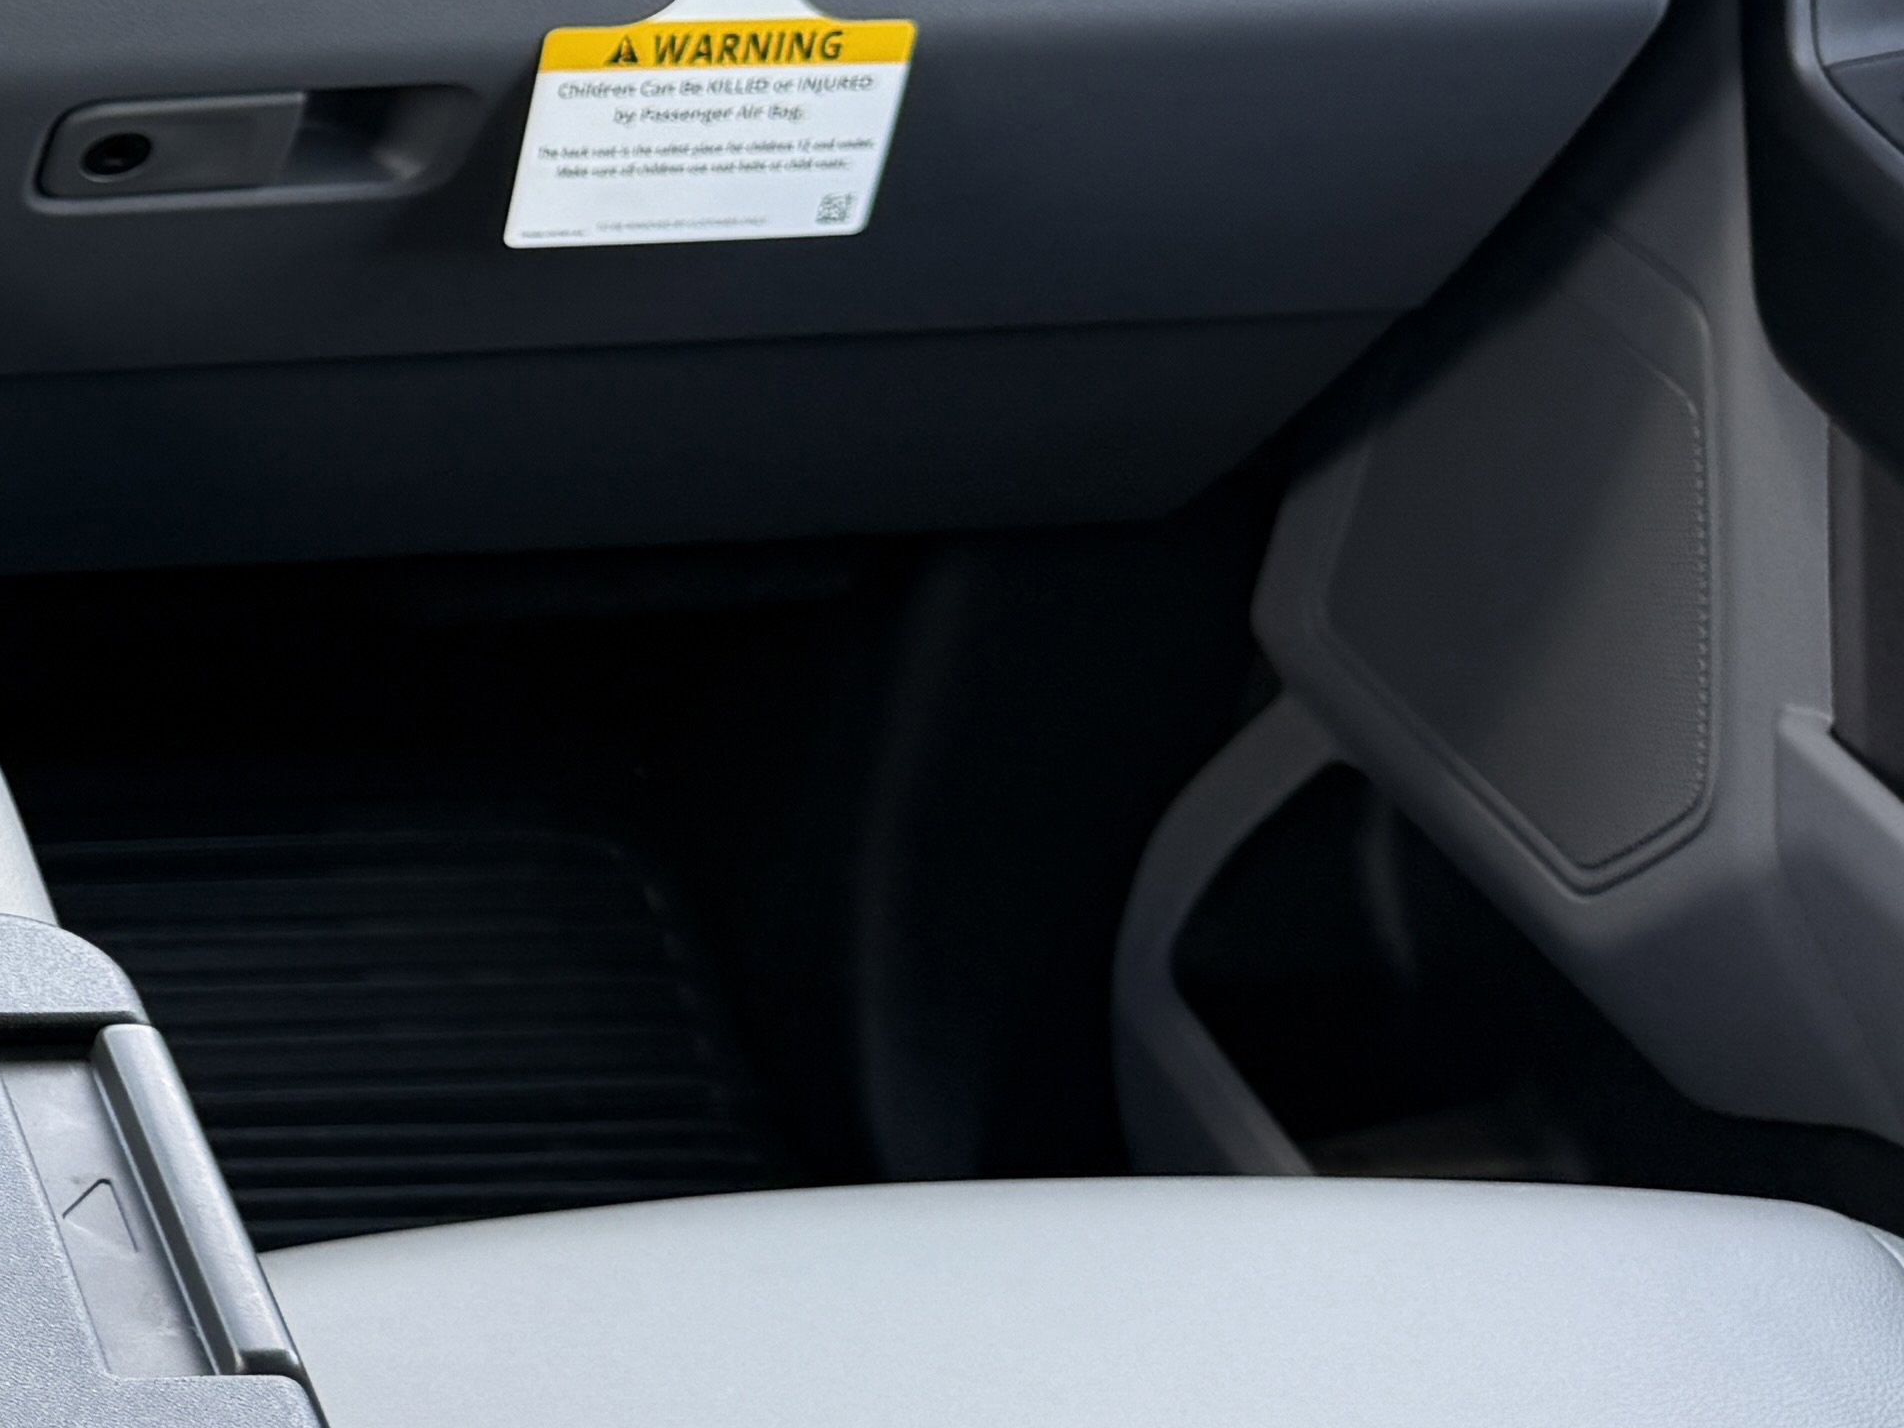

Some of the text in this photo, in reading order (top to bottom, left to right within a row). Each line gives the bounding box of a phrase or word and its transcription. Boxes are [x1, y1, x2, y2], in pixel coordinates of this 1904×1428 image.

[653, 29, 845, 66] WARNING
[556, 74, 874, 100] Children Can Be KILLED or INJURED
[613, 107, 634, 125] by
[638, 105, 733, 125] Passenger
[736, 103, 764, 119] Air
